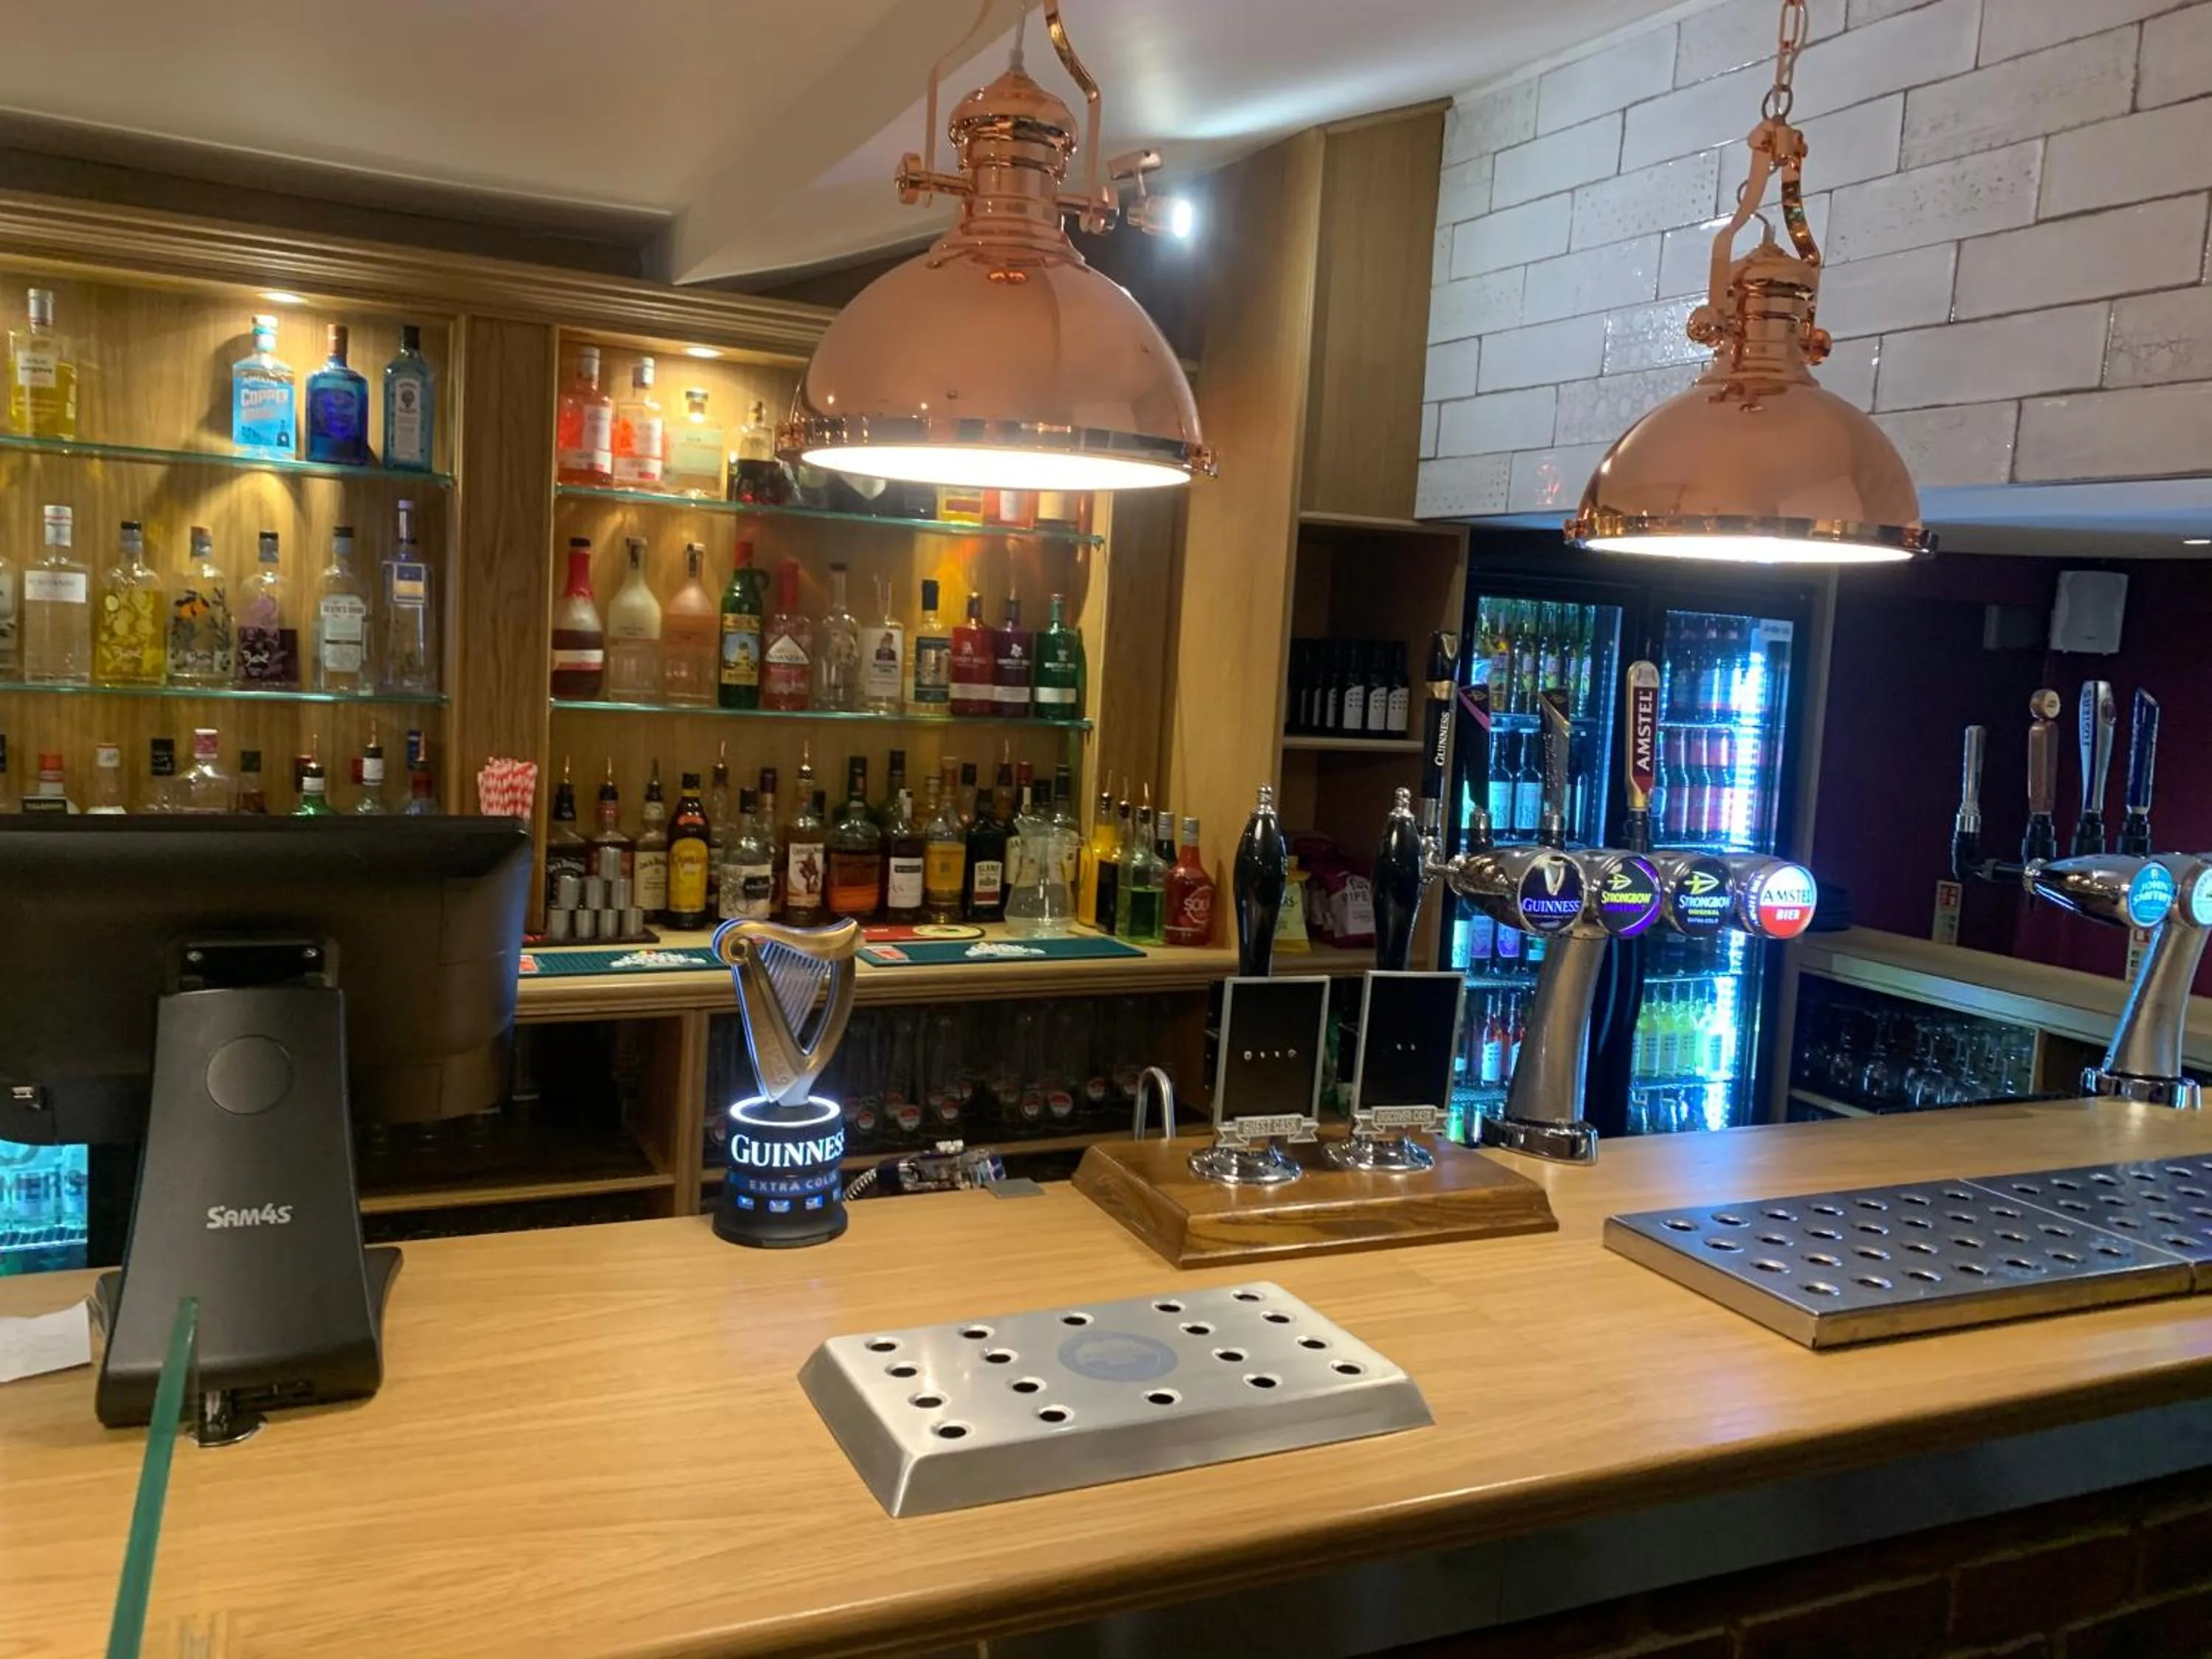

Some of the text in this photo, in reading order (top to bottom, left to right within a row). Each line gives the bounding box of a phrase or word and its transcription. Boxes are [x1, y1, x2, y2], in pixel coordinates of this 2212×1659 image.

[1636, 691, 1653, 771] AMSTEL
[1434, 712, 1451, 766] GUINNESS
[1601, 891, 1652, 903] STRONGBOW
[1678, 894, 1733, 909] STRONGBOW
[1522, 897, 1581, 913] GUINNESS
[1775, 908, 1800, 921] BIER
[748, 1180, 800, 1192] EXTRA
[206, 1203, 293, 1229] SAM4S
